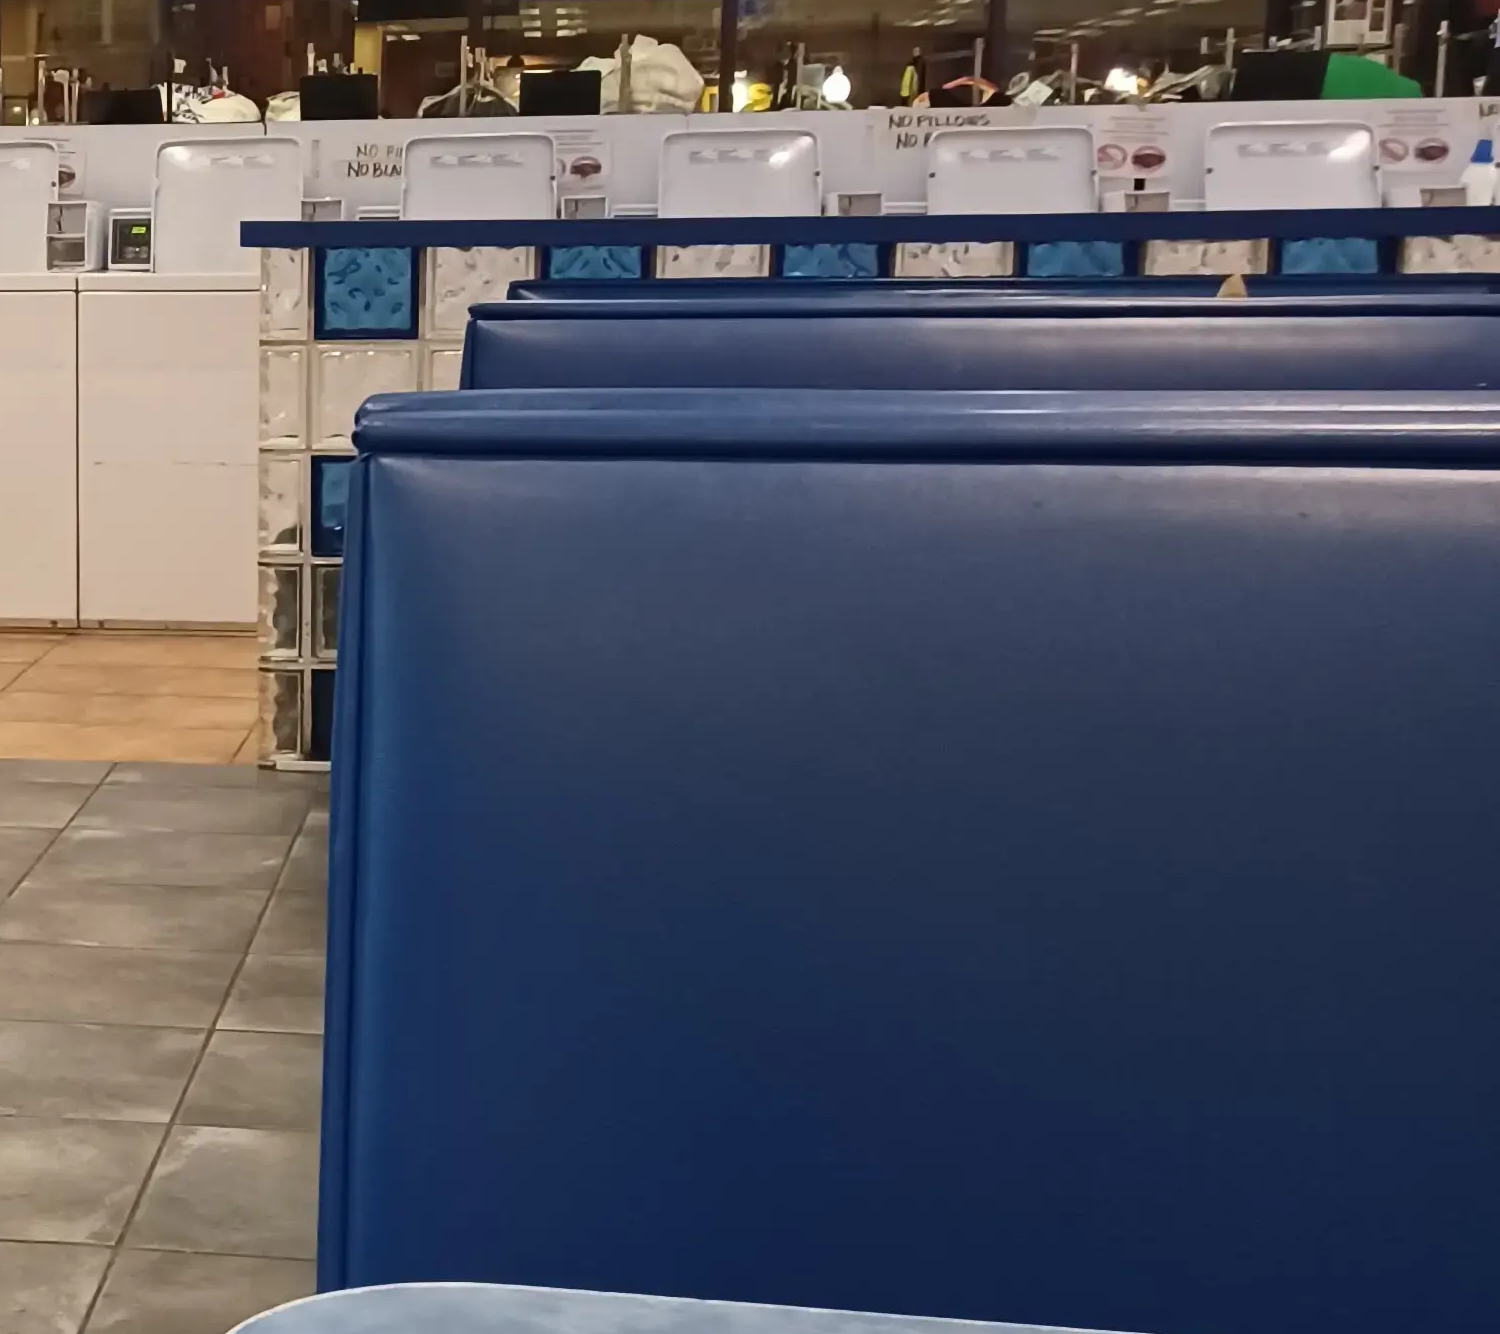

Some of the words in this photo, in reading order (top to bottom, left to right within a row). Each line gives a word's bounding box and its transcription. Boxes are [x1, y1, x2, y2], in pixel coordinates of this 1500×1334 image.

[888, 114, 913, 129] NO
[896, 132, 918, 149] NO
[356, 143, 379, 158] NO
[347, 161, 369, 177] NO
